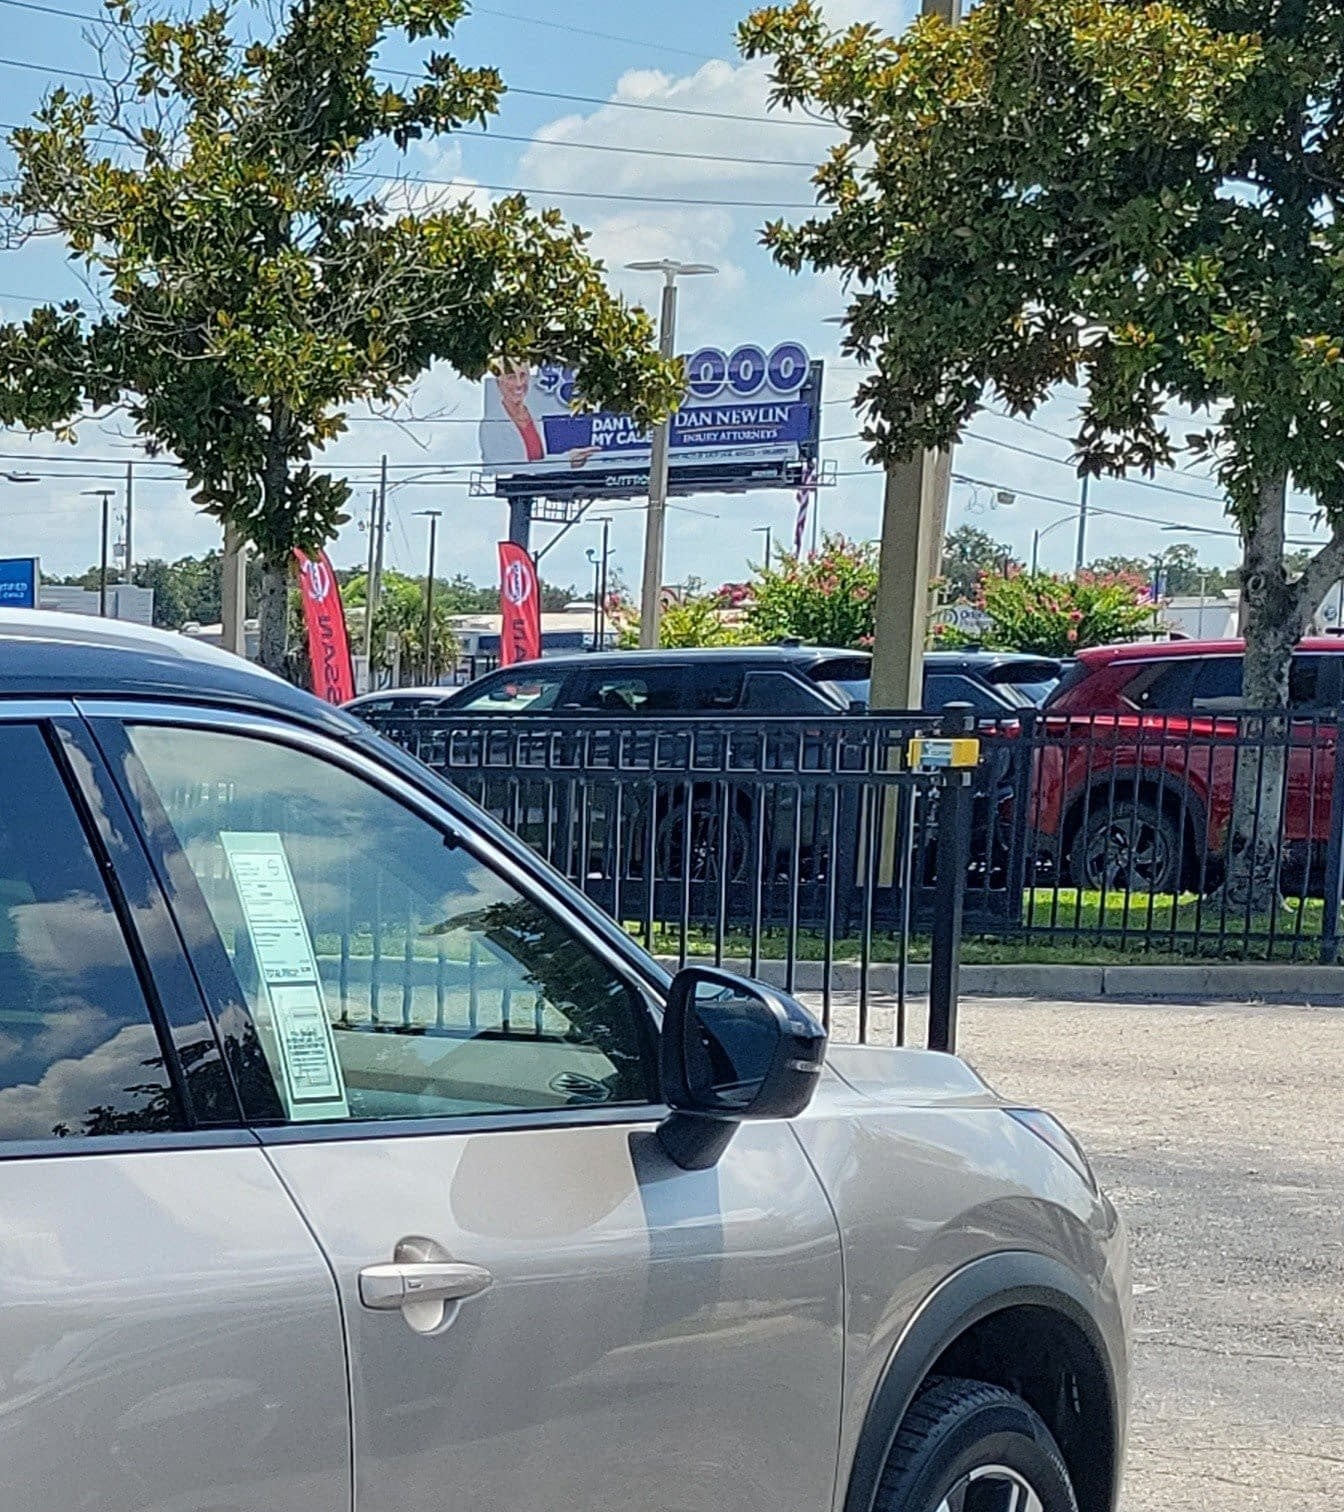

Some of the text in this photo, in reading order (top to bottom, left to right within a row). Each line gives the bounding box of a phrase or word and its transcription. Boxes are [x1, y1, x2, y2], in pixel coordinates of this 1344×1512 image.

[674, 411, 712, 428] DAN
[716, 406, 789, 425] NEWLIN
[593, 417, 624, 432] DAN
[592, 433, 613, 446] MY
[720, 428, 778, 441] ATTORNEYS
